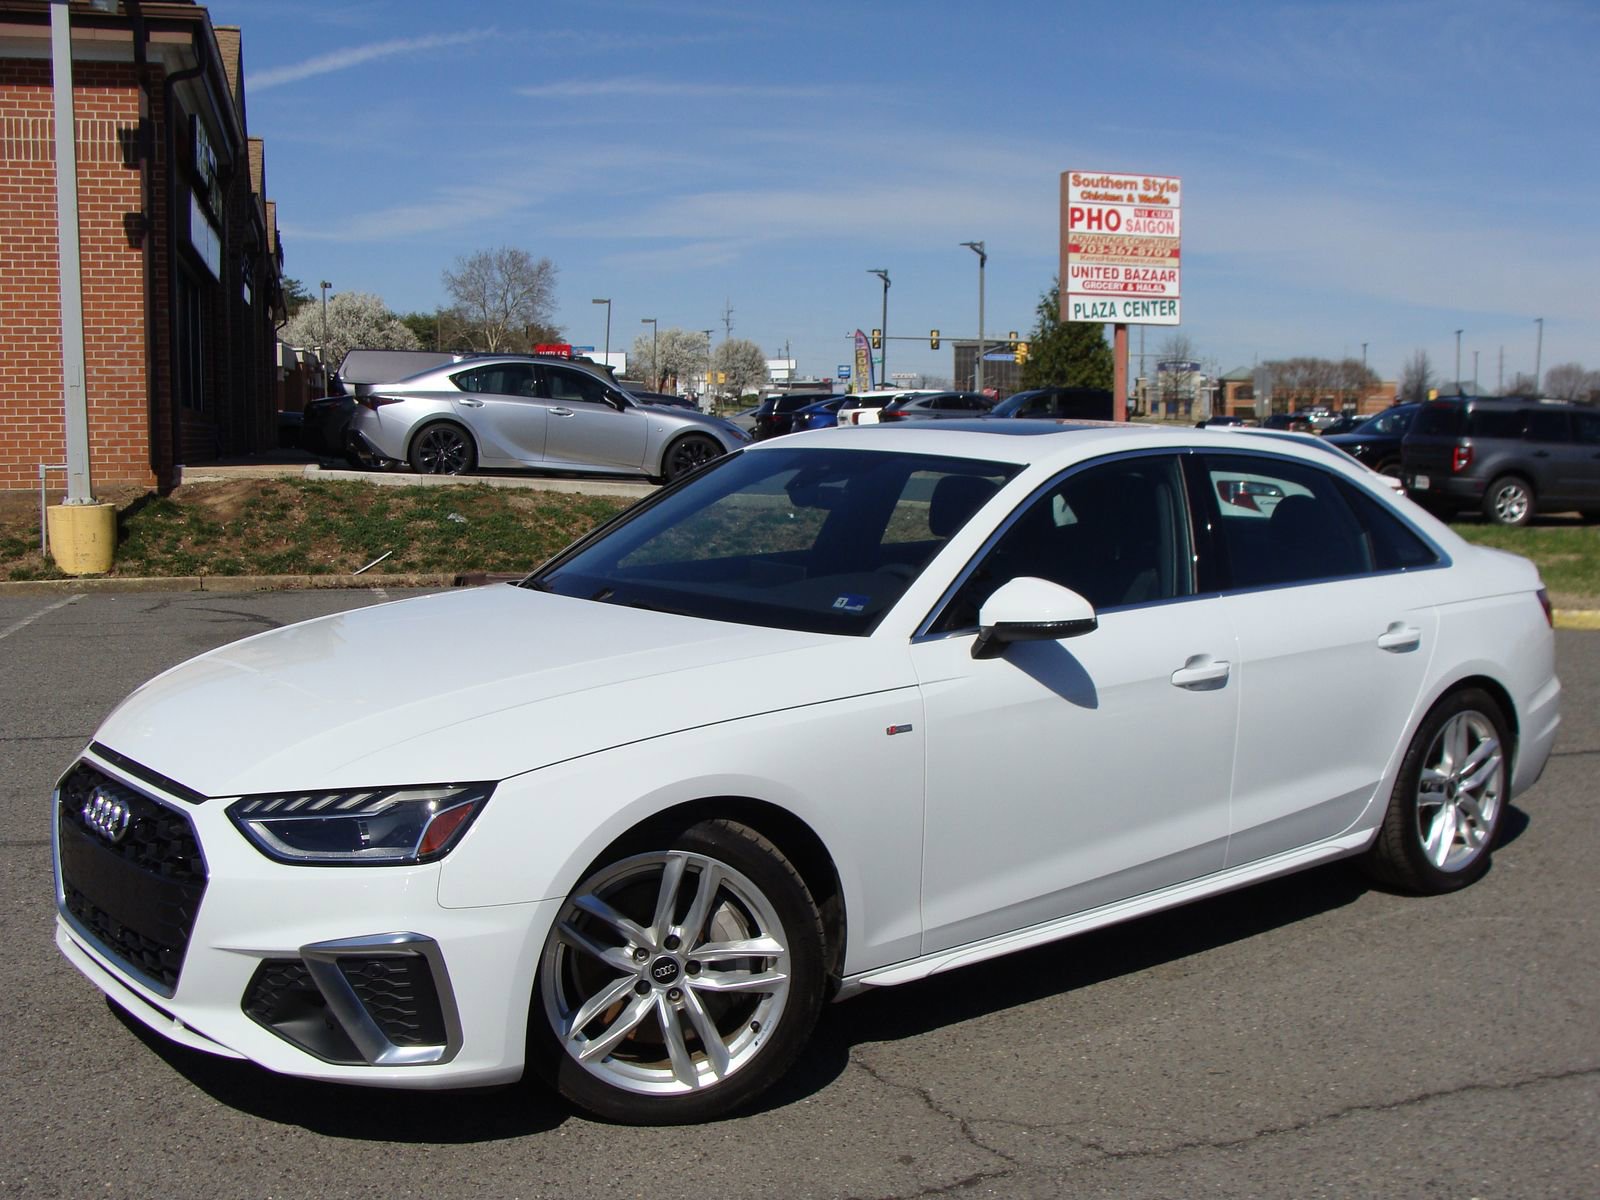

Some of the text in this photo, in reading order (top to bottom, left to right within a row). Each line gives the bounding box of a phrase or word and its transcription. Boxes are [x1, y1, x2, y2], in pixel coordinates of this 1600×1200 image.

[1072, 174, 1179, 195] Southern Style
[1070, 207, 1121, 231] PHO
[1126, 219, 1175, 234] SAIGON
[1071, 266, 1176, 282] UNITED BAZAAR
[1084, 281, 1124, 290] GROCERY
[1074, 300, 1177, 319] PLAZA CENTER
